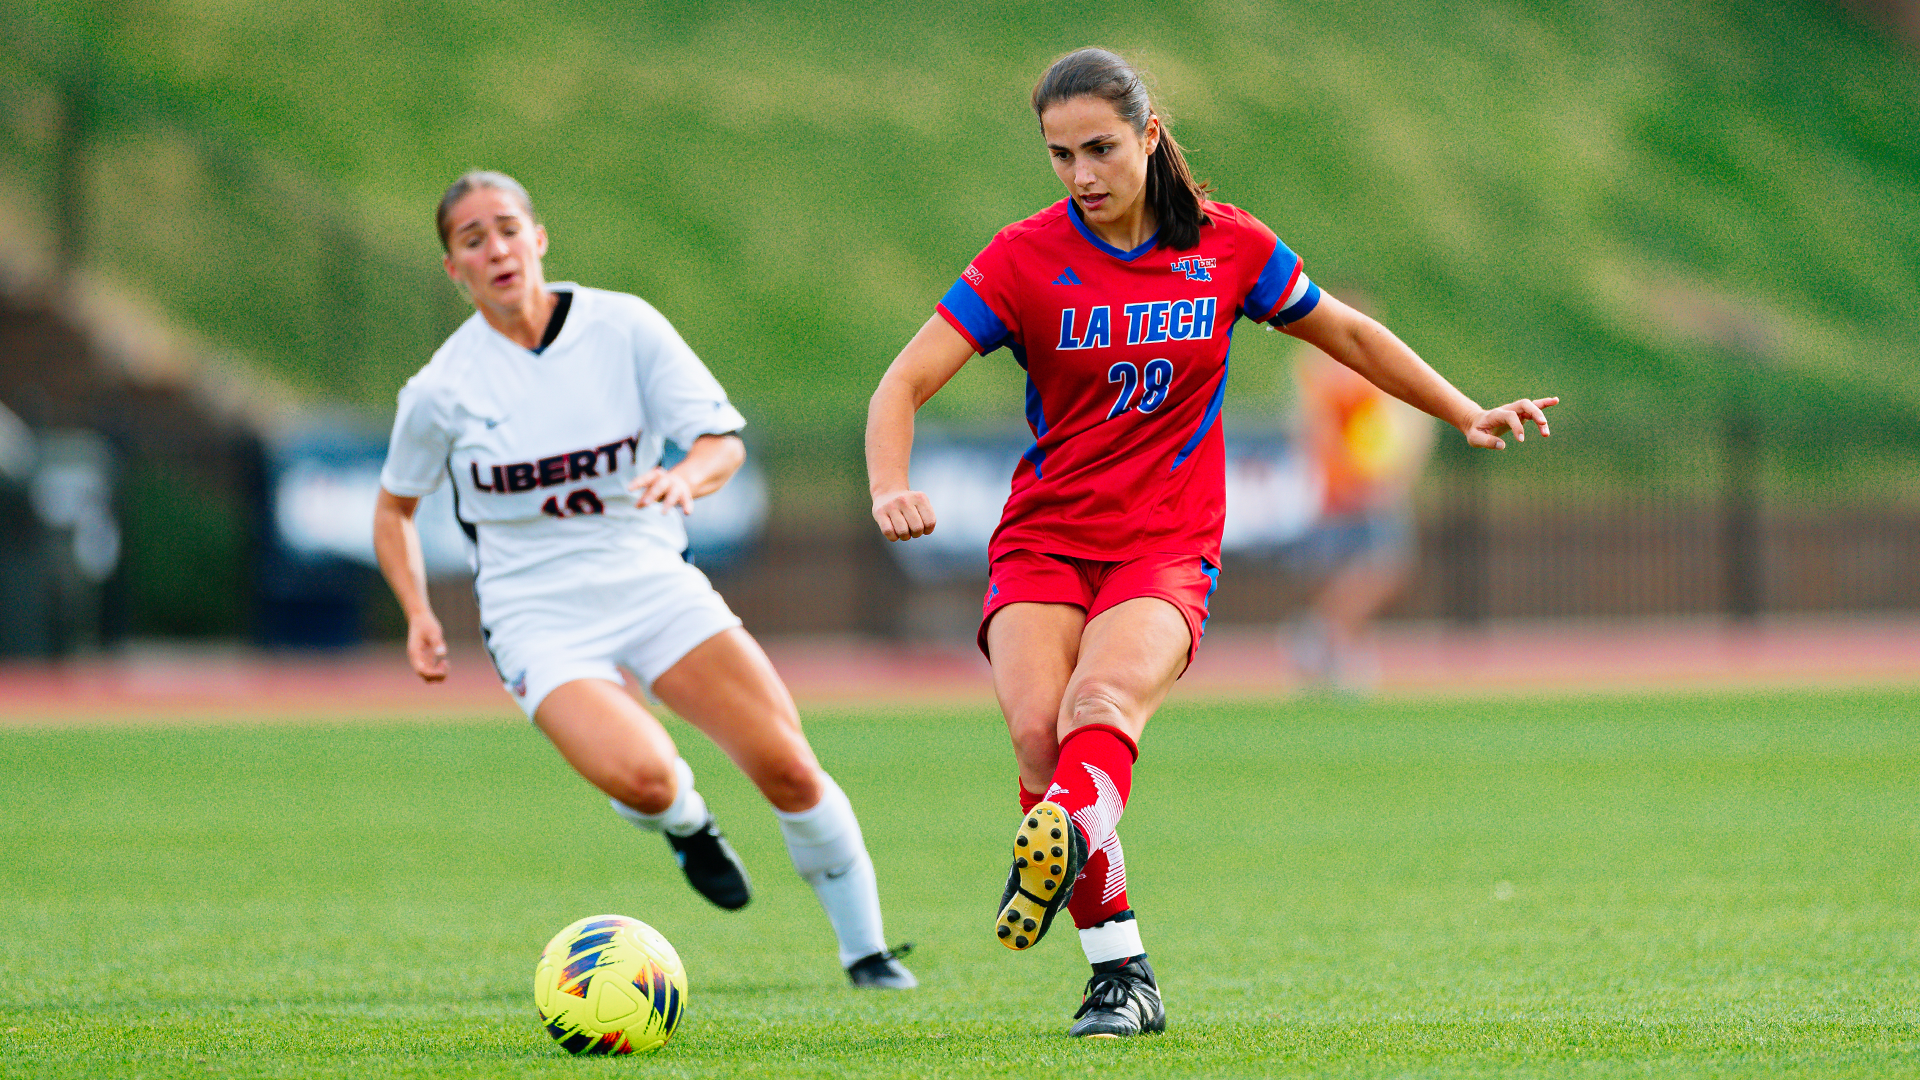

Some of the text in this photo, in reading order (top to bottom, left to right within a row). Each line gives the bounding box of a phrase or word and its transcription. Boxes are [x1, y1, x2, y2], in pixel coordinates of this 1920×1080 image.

[1171, 262, 1187, 272] LA
[1057, 297, 1217, 350] LA TECH
[1106, 358, 1173, 420] 28
[470, 430, 642, 493] LIBERTY
